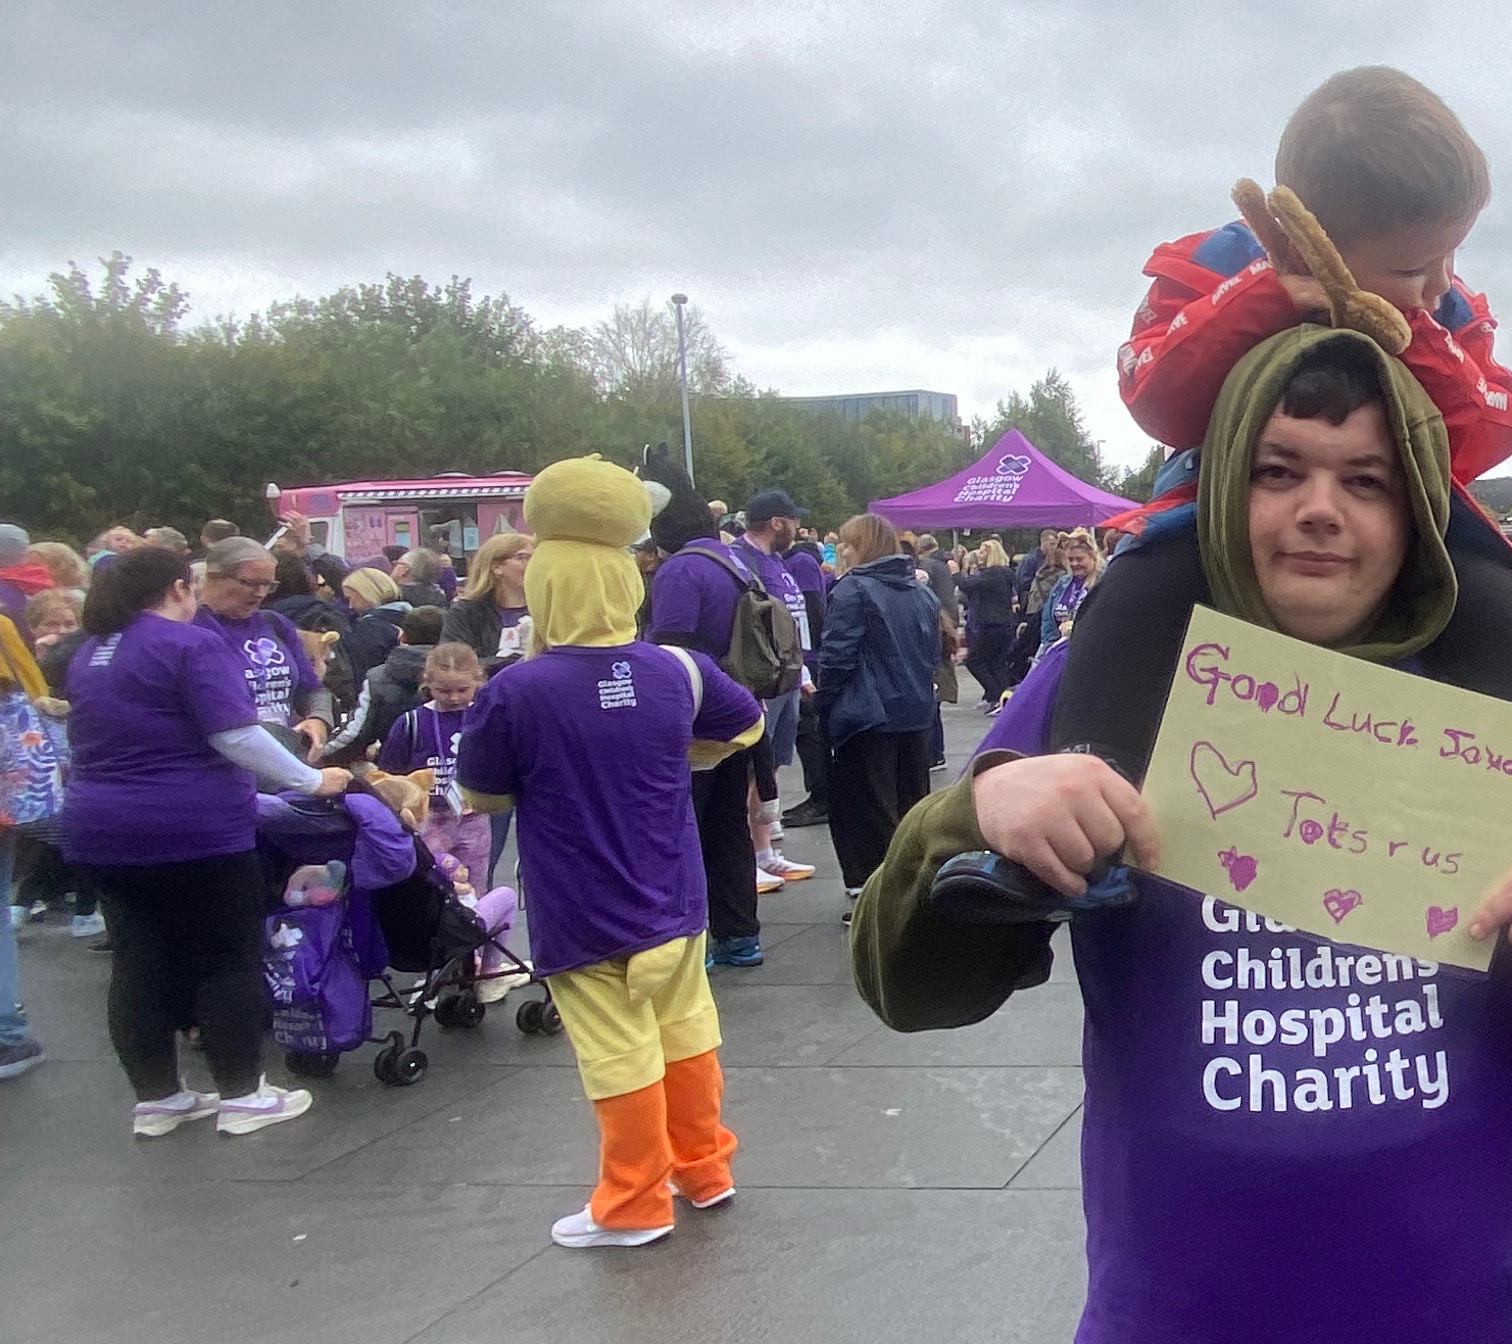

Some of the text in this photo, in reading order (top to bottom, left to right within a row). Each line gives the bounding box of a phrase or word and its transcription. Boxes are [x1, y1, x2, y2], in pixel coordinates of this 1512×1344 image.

[953, 494, 1013, 503] Charity
[958, 487, 1017, 496] Hospital
[966, 476, 1023, 485] Glasgow
[1186, 643, 1309, 717] Good
[1323, 692, 1418, 746] Luck
[1281, 790, 1463, 874] Tots r us
[1201, 983, 1444, 1057] Hospital
[1203, 1048, 1450, 1112] Charity
